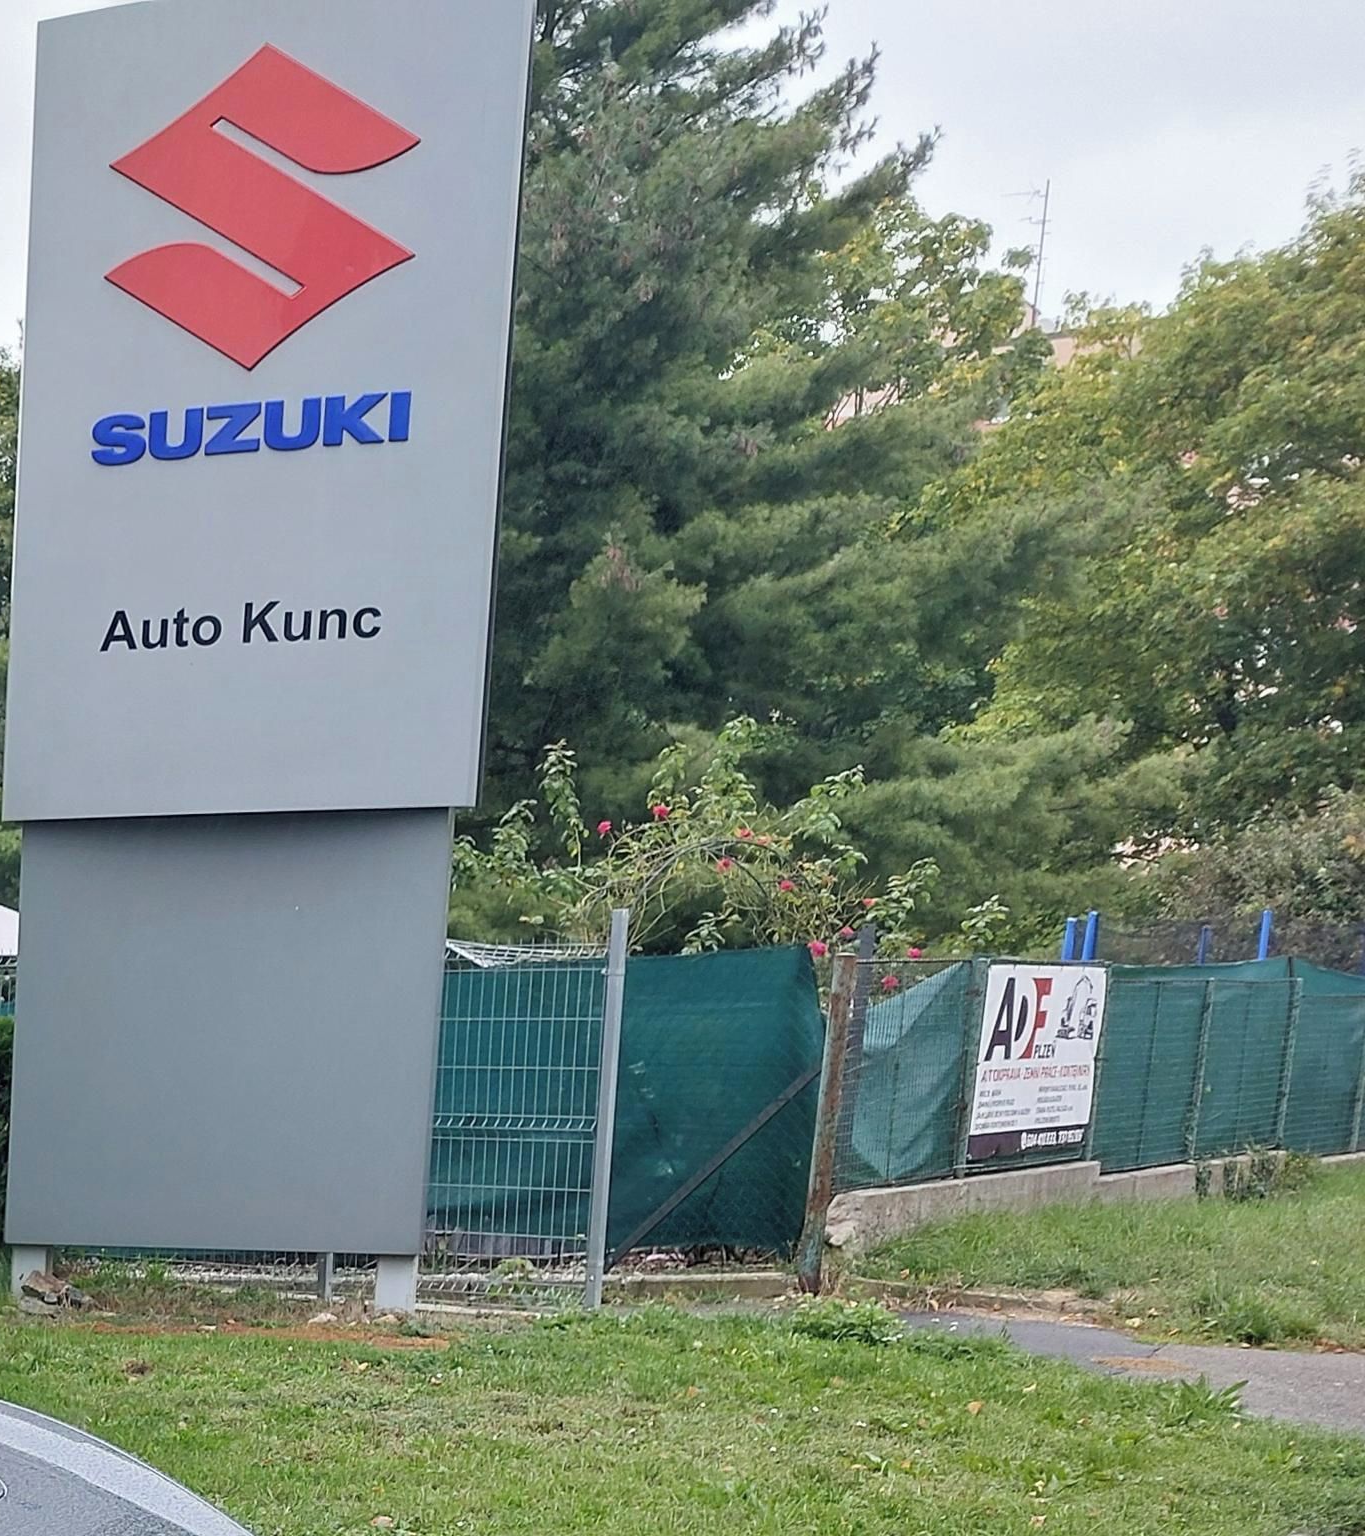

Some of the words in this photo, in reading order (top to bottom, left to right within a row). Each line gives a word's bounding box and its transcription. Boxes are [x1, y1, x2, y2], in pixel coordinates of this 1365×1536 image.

[90, 389, 412, 467] SUZUKI
[99, 608, 223, 653] Auto
[242, 600, 383, 644] Kunc
